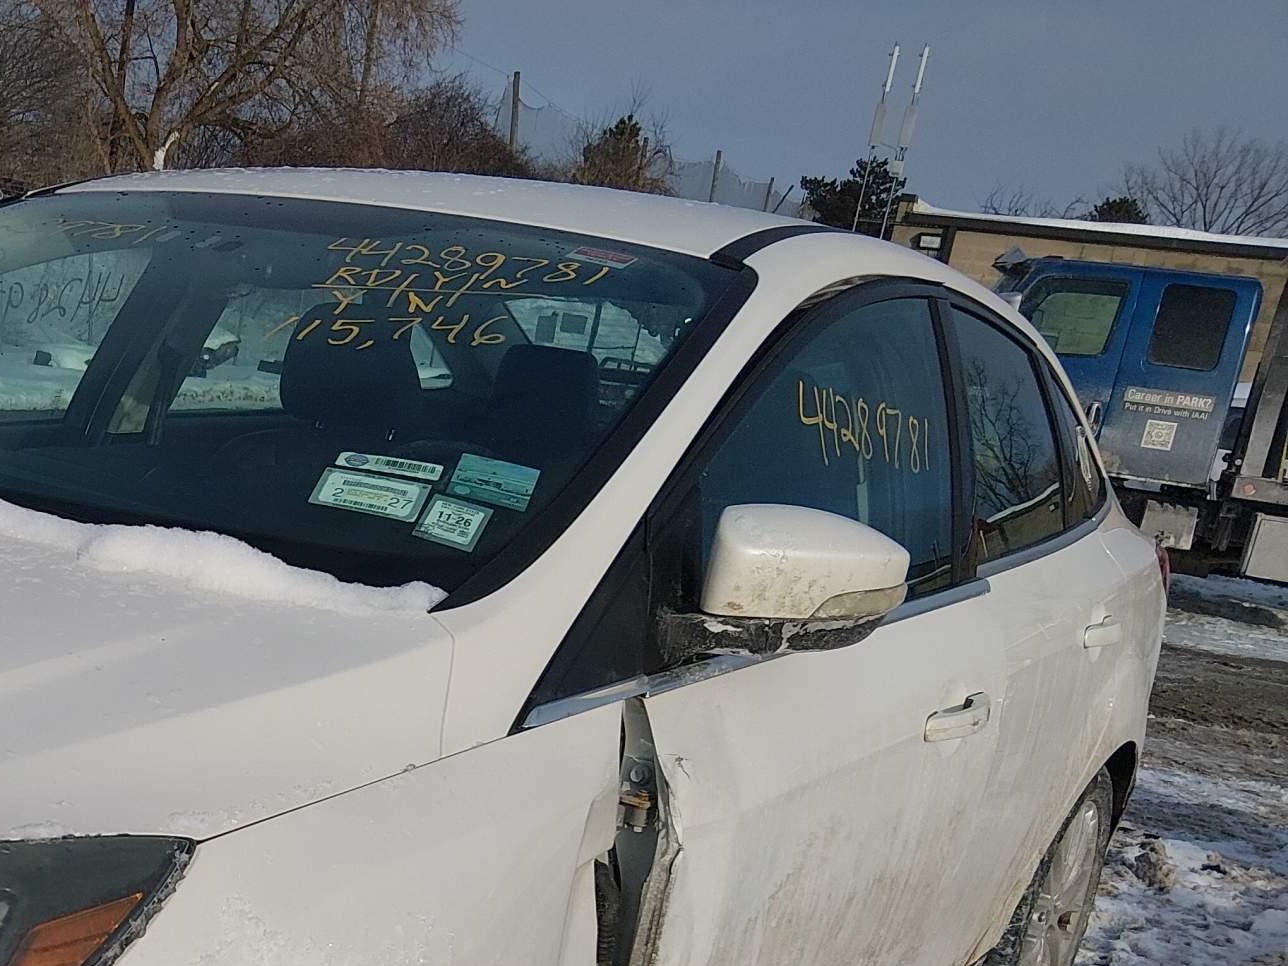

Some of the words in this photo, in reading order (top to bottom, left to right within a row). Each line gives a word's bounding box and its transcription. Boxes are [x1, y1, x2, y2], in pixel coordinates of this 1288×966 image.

[326, 237, 610, 286] 44289781
[262, 314, 509, 350] 115,746
[1124, 402, 1137, 411] Put
[1153, 406, 1172, 416] Drive
[1173, 408, 1190, 418] with
[1128, 388, 1163, 402] Career
[1164, 393, 1174, 404] in
[1176, 394, 1213, 409] PARK?
[797, 379, 930, 474] 44289781
[332, 487, 345, 498] 2
[388, 496, 414, 511] 27
